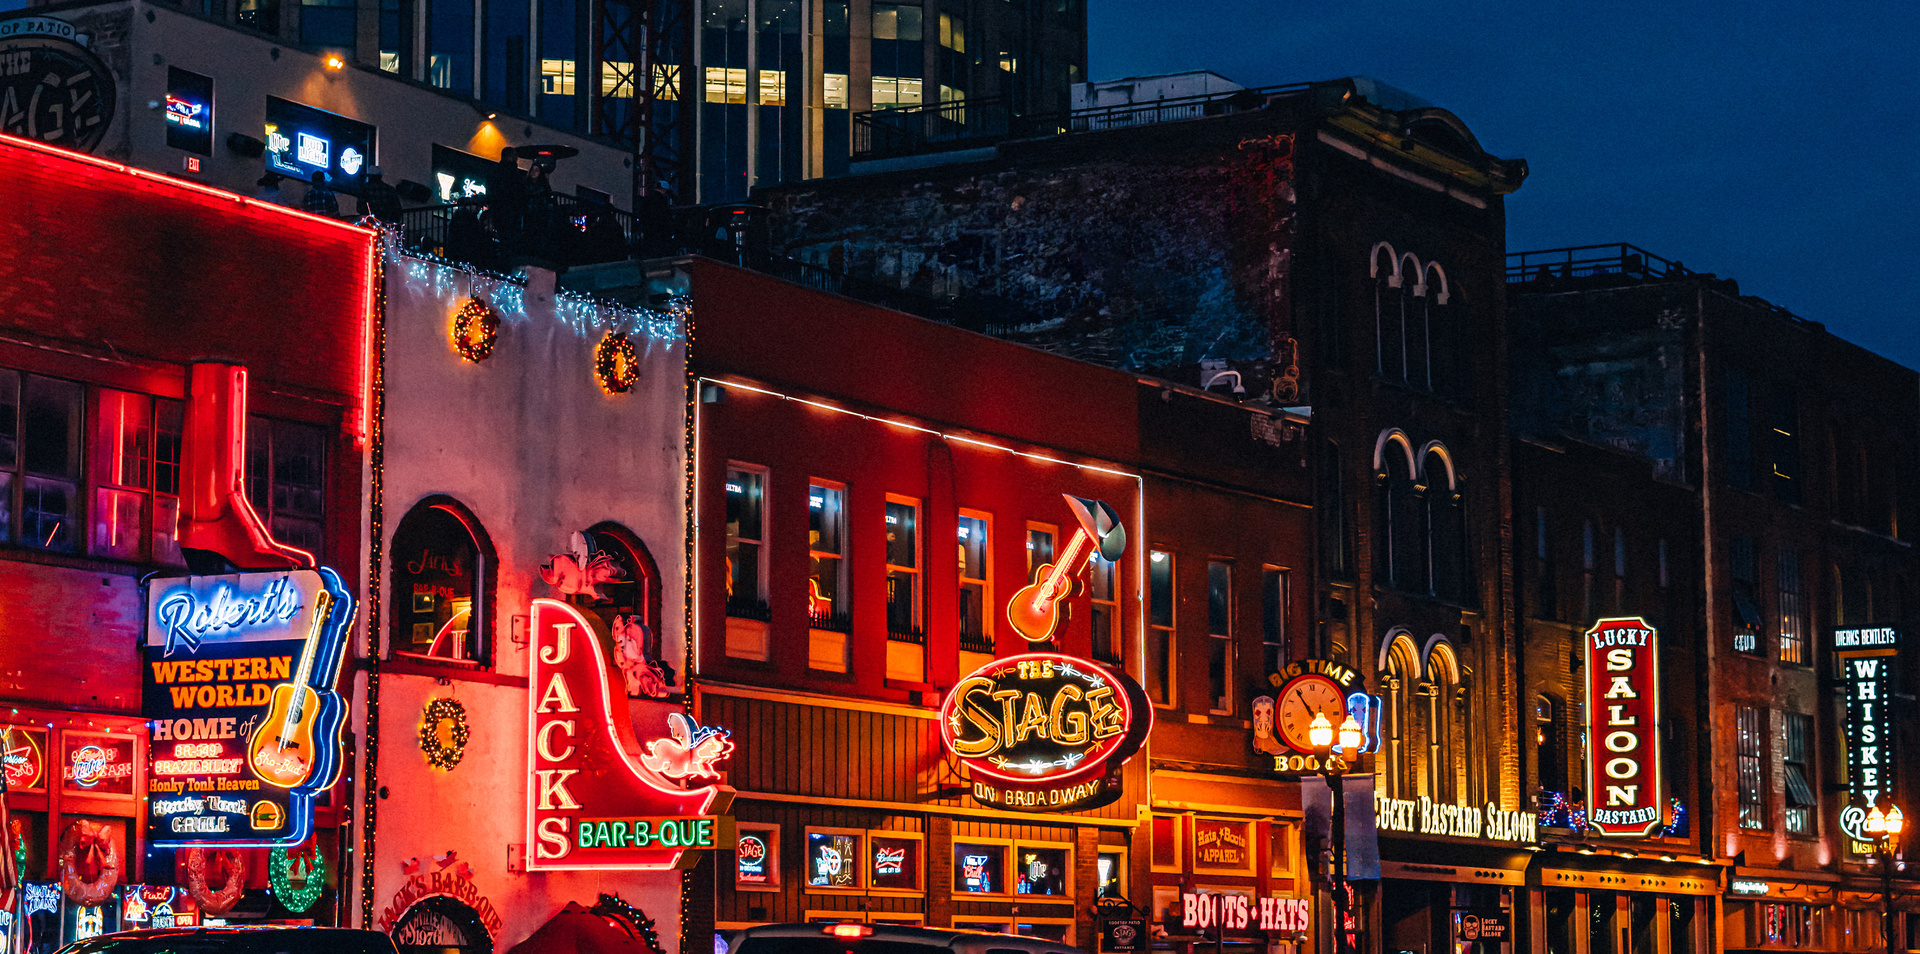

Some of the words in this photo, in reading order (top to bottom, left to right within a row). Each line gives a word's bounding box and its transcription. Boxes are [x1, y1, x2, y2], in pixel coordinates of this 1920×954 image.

[27, 21, 71, 36] PATIO
[303, 136, 323, 152] BUD
[189, 158, 199, 171] EXIT
[300, 146, 326, 165] LIGHT
[159, 576, 304, 658] Robert's
[1592, 628, 1650, 649] LUCKY
[1835, 629, 1860, 647] DIERKS
[152, 655, 292, 684] WESTERN
[1017, 660, 1054, 680] THE
[1268, 663, 1302, 688] BIG
[1306, 659, 1355, 687] TIME
[169, 683, 271, 709] WORLD
[953, 677, 1123, 758] STAGE
[1604, 649, 1639, 807] SALOON
[153, 717, 236, 741] HOME
[239, 714, 258, 743] of
[1854, 659, 1879, 808] WHISKEY
[174, 743, 223, 758] BR-549
[536, 622, 582, 860] JACKS
[154, 758, 243, 775] BRAZILBILLY
[254, 751, 305, 776] Sho-Bud
[149, 777, 184, 795] Honky
[186, 777, 216, 792] Tonk
[217, 778, 260, 792] Heaven
[974, 782, 998, 802] ON
[1005, 779, 1099, 806] BROADWAY
[153, 796, 204, 816] Honky
[207, 795, 249, 816] Tonk
[1594, 806, 1656, 825] BASTARD
[1420, 795, 1482, 838] BASTARD
[1486, 801, 1537, 843] SALOON
[579, 819, 712, 848] BAR-B-QUE
[1197, 830, 1217, 846] Hats
[1223, 827, 1246, 848] Boots
[739, 841, 763, 858] STAGE
[1203, 849, 1239, 864] APPAREL
[1029, 861, 1047, 882] Lite
[378, 875, 427, 934] JACK'S
[1183, 893, 1248, 929] BOOTS
[1260, 897, 1309, 931] HATS
[177, 916, 193, 925] OPEN
[1115, 927, 1135, 938] STAGE
